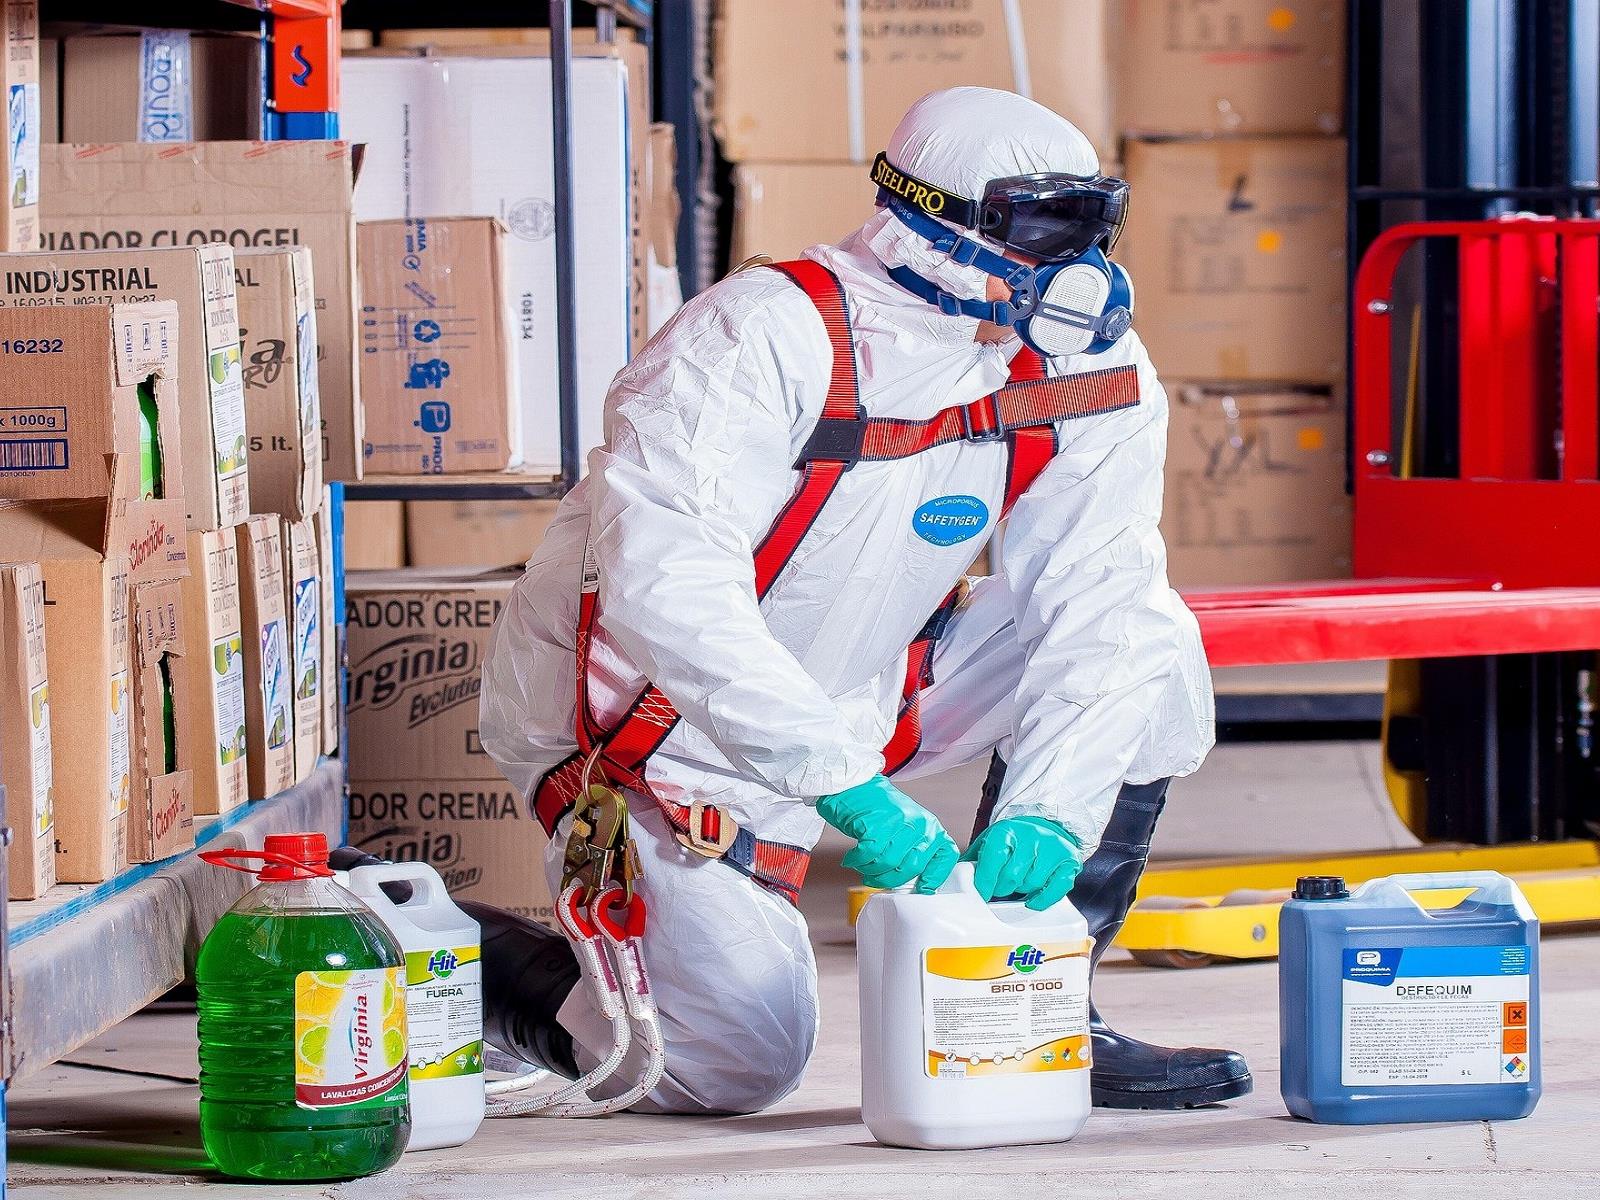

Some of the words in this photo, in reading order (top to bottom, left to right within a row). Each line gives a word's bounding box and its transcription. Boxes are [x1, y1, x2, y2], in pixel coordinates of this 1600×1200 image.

[874, 159, 945, 215] STEELPRO
[6, 267, 158, 293] INDUSTRIAL
[521, 292, 534, 341] 108134
[1, 338, 64, 354] 16232
[10, 415, 56, 427] 1000g
[919, 512, 980, 527] SAFETYGEN
[417, 792, 520, 820] CREMA
[427, 951, 459, 972] Hit
[1006, 947, 1046, 967] Hit
[426, 988, 464, 999] FUERA
[990, 983, 1026, 994] BRIO
[1028, 981, 1064, 992] 1000
[1396, 985, 1472, 996] DEFEQUIM
[354, 994, 373, 1080] Virginia
[321, 1086, 367, 1099] LAVALOZAS
